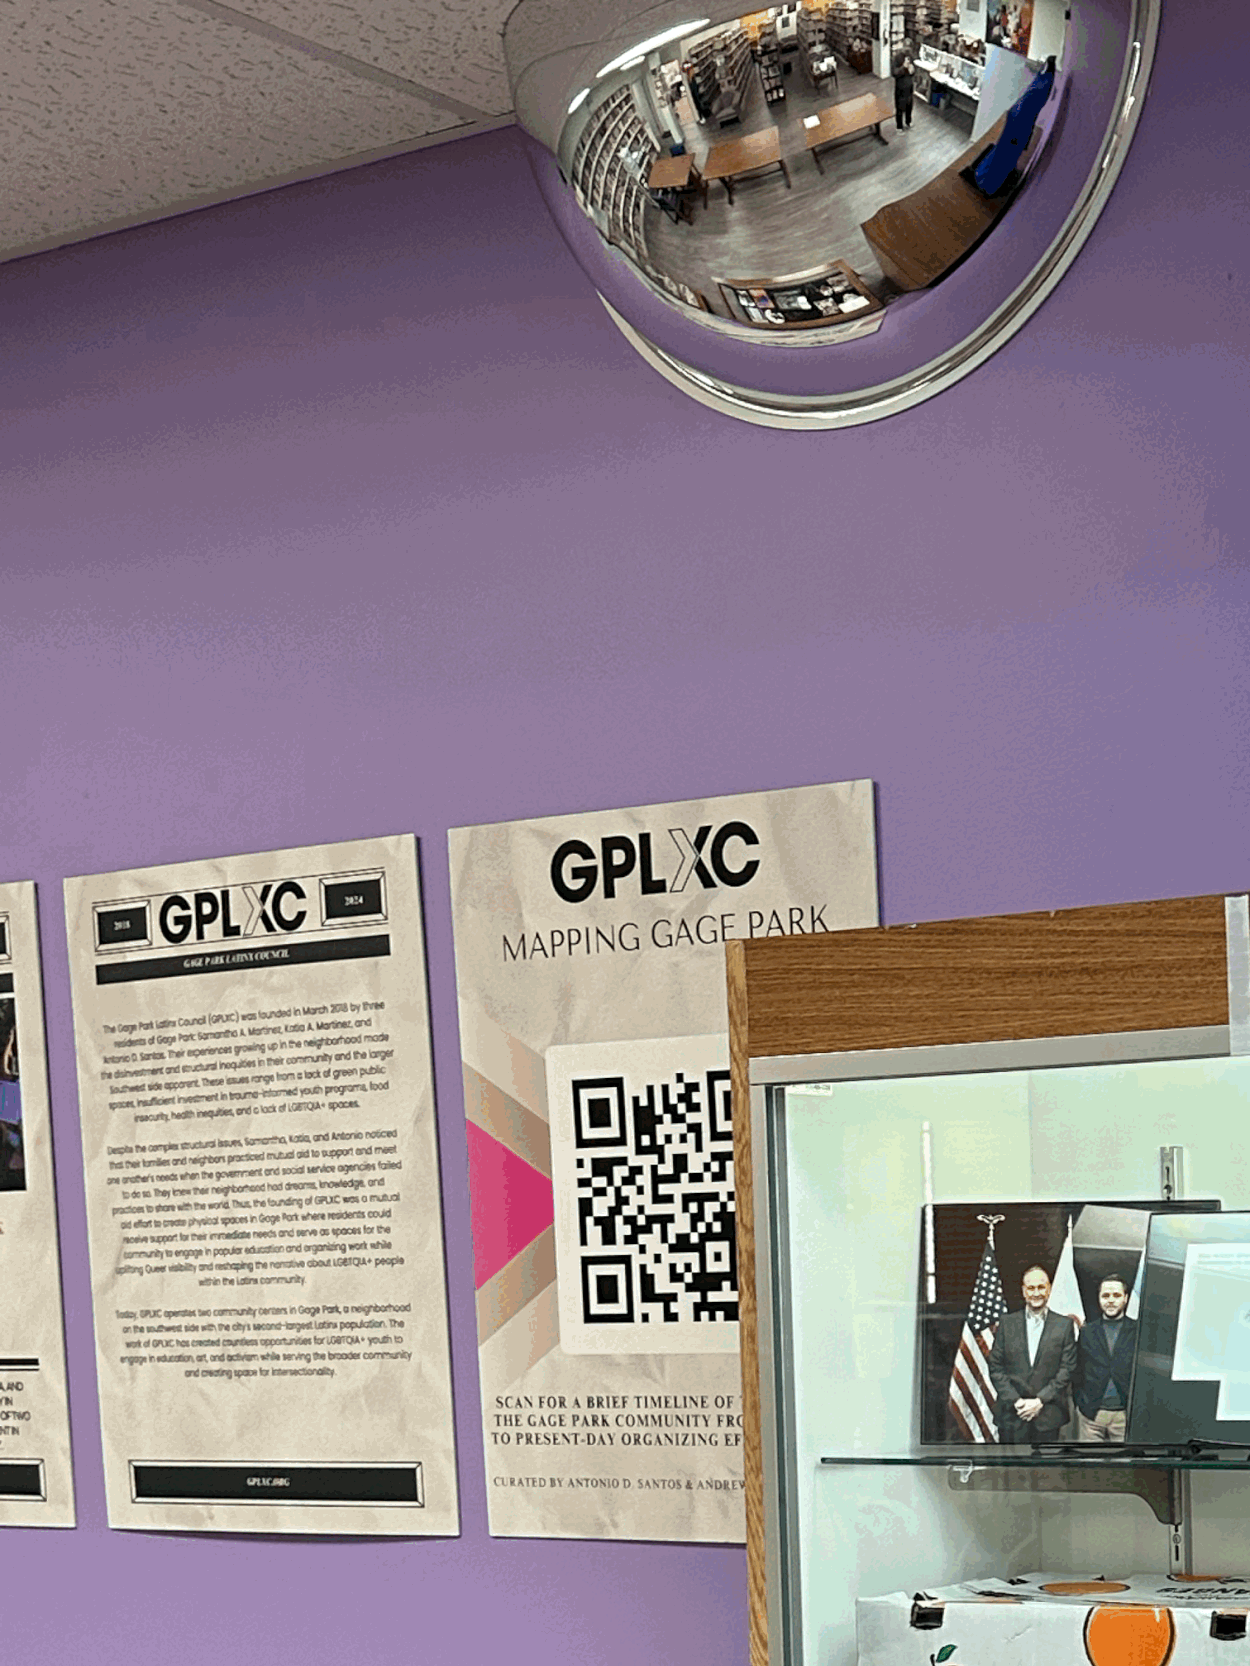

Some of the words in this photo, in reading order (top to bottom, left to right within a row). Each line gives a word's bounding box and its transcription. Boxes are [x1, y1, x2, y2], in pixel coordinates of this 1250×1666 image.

[550, 821, 761, 904] GPLXC
[159, 881, 307, 944] GPLXC
[501, 922, 641, 962] MAPPING
[651, 913, 736, 948] GAGE
[748, 904, 829, 938] PARK
[183, 958, 204, 968] GAGE
[204, 955, 225, 967] PARK
[225, 952, 254, 965] LATINX
[254, 949, 290, 962] COUNCIL
[495, 1396, 533, 1409] SCAN
[538, 1395, 567, 1409] FOR
[572, 1395, 582, 1409] A
[586, 1395, 629, 1409] BRIEF
[633, 1395, 709, 1409] TIMELINE
[714, 1395, 735, 1409] OF
[493, 1414, 523, 1427] THE
[527, 1414, 567, 1427] GAGE
[572, 1414, 610, 1427] PARK
[615, 1414, 711, 1427] COMMUNITY
[717, 1414, 744, 1427] FRO
[492, 1432, 511, 1445] TO
[516, 1432, 616, 1446] PRESENT-DAY
[621, 1433, 719, 1447] ORGANIZING
[724, 1433, 742, 1446] EF
[493, 1476, 546, 1488] CURATED
[550, 1477, 564, 1488] BY
[567, 1477, 619, 1489] ANTONIO
[637, 1478, 682, 1490] SANTOS
[697, 1479, 746, 1491] ANDREW
